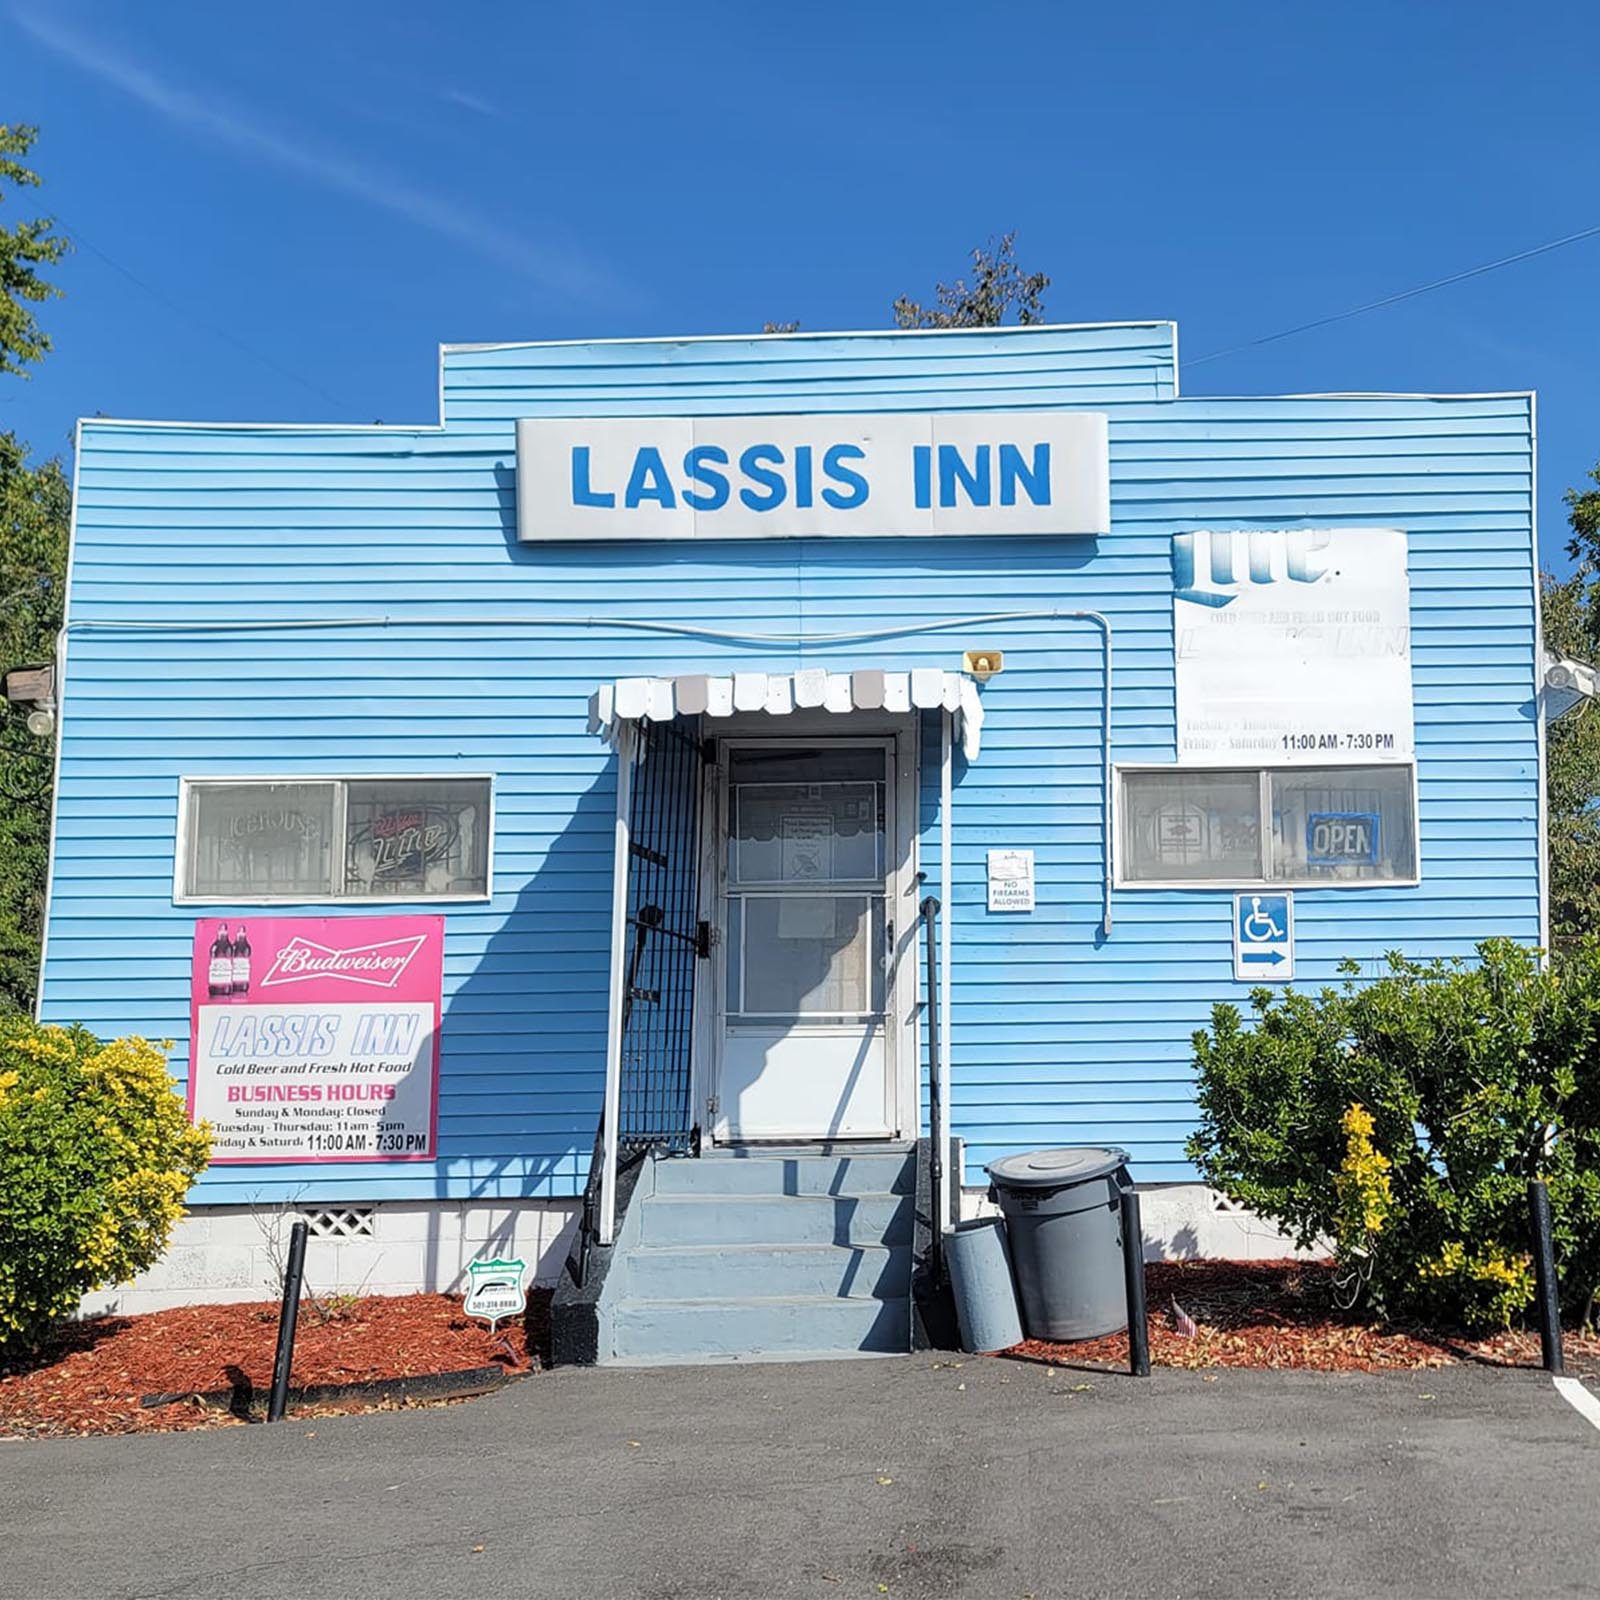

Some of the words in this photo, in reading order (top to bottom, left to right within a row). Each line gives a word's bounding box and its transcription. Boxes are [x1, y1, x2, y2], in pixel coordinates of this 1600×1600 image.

[571, 443, 870, 513] LASSIS
[913, 443, 1051, 508] INN
[1282, 734, 1316, 749] 11:00
[1318, 734, 1338, 749] AM
[1346, 734, 1373, 749] 7:30
[1375, 734, 1394, 749] PM
[1313, 824, 1371, 853] OPEN
[1004, 881, 1018, 889] NO
[275, 948, 407, 973] Budweiser
[209, 1015, 341, 1058] LASSIS
[350, 1014, 420, 1056] INN
[216, 1063, 246, 1075] Cold
[247, 1063, 279, 1075] Beer
[280, 1062, 307, 1074] and
[308, 1062, 347, 1073] Fresh
[350, 1061, 377, 1073] Hot
[377, 1061, 412, 1073] Food
[228, 1084, 323, 1102] BUSINESS
[327, 1083, 396, 1101] HOURS
[235, 1108, 279, 1119] Sunday
[281, 1107, 289, 1117] &
[293, 1106, 344, 1118] Monday:
[346, 1106, 386, 1117] Closed
[214, 1122, 264, 1134] Tuesday
[337, 1121, 369, 1131] 11am
[376, 1121, 405, 1132] 5pm
[214, 1137, 246, 1149] riday
[247, 1137, 256, 1147] &
[308, 1134, 343, 1150] 11:00
[345, 1134, 366, 1150] AM
[376, 1134, 403, 1150] 7:30
[406, 1134, 426, 1150] PM
